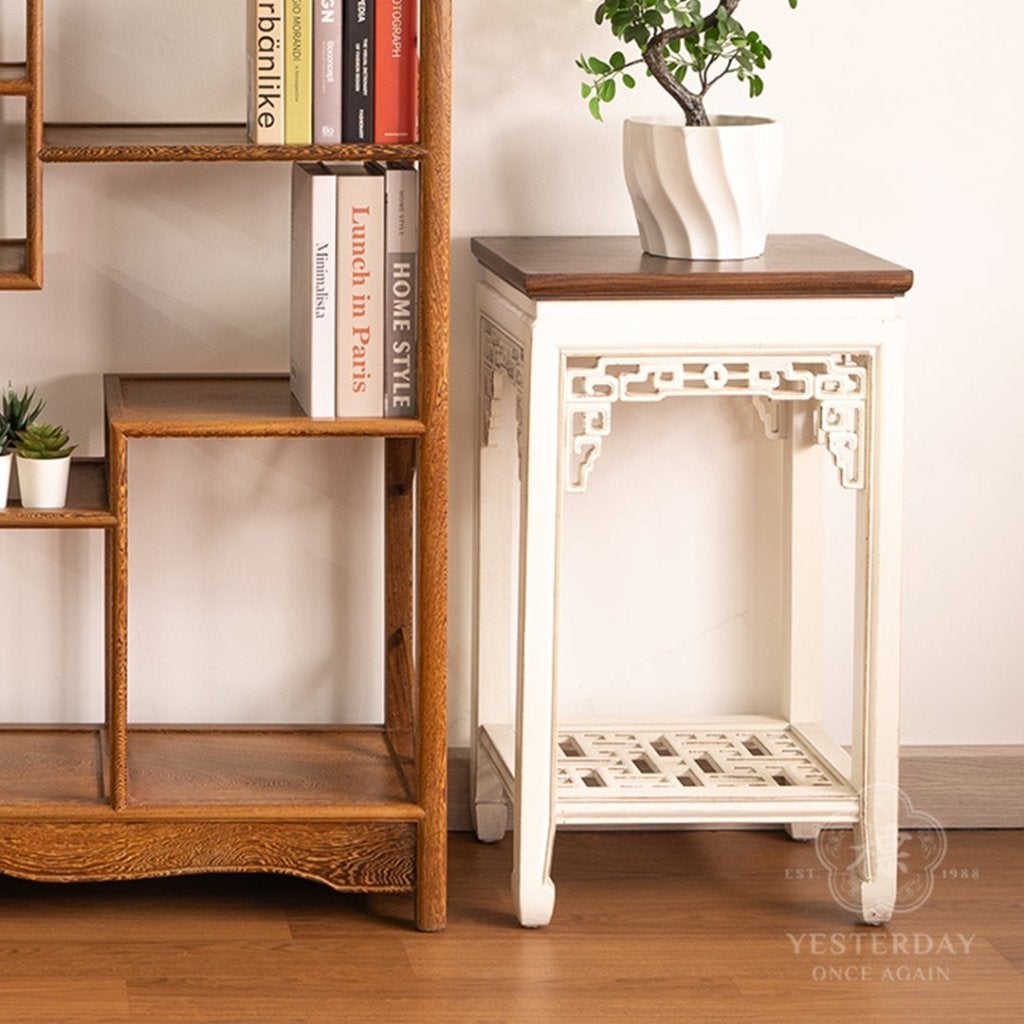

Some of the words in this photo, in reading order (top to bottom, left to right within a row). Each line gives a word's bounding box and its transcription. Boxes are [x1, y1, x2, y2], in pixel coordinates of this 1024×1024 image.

[292, 15, 302, 61] MORANDI
[352, 206, 371, 286] Lunch
[316, 243, 329, 319] Minimalista
[352, 294, 371, 318] in
[392, 262, 411, 331] HOME
[352, 326, 371, 394] Paris
[392, 340, 411, 408] STYLE
